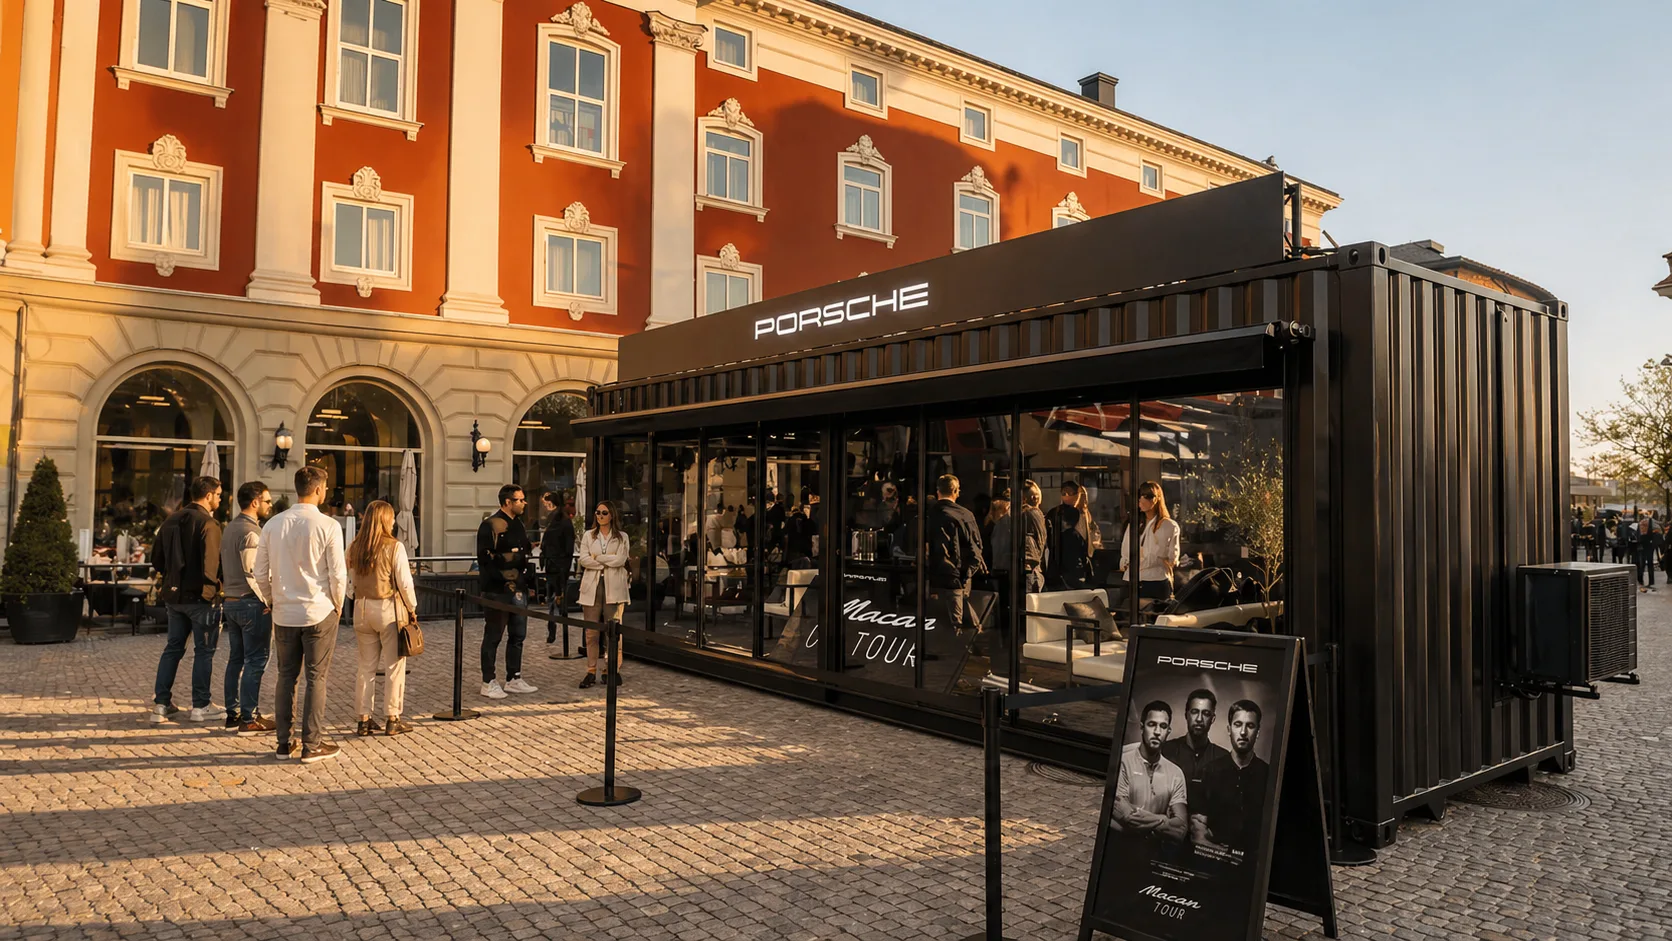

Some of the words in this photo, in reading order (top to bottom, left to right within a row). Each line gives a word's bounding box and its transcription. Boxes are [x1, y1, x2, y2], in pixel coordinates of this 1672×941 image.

[755, 282, 929, 340] PORSCHE
[1157, 655, 1258, 674] PORSCHE
[1138, 885, 1201, 909] Macan
[1153, 901, 1186, 920] TOUR
